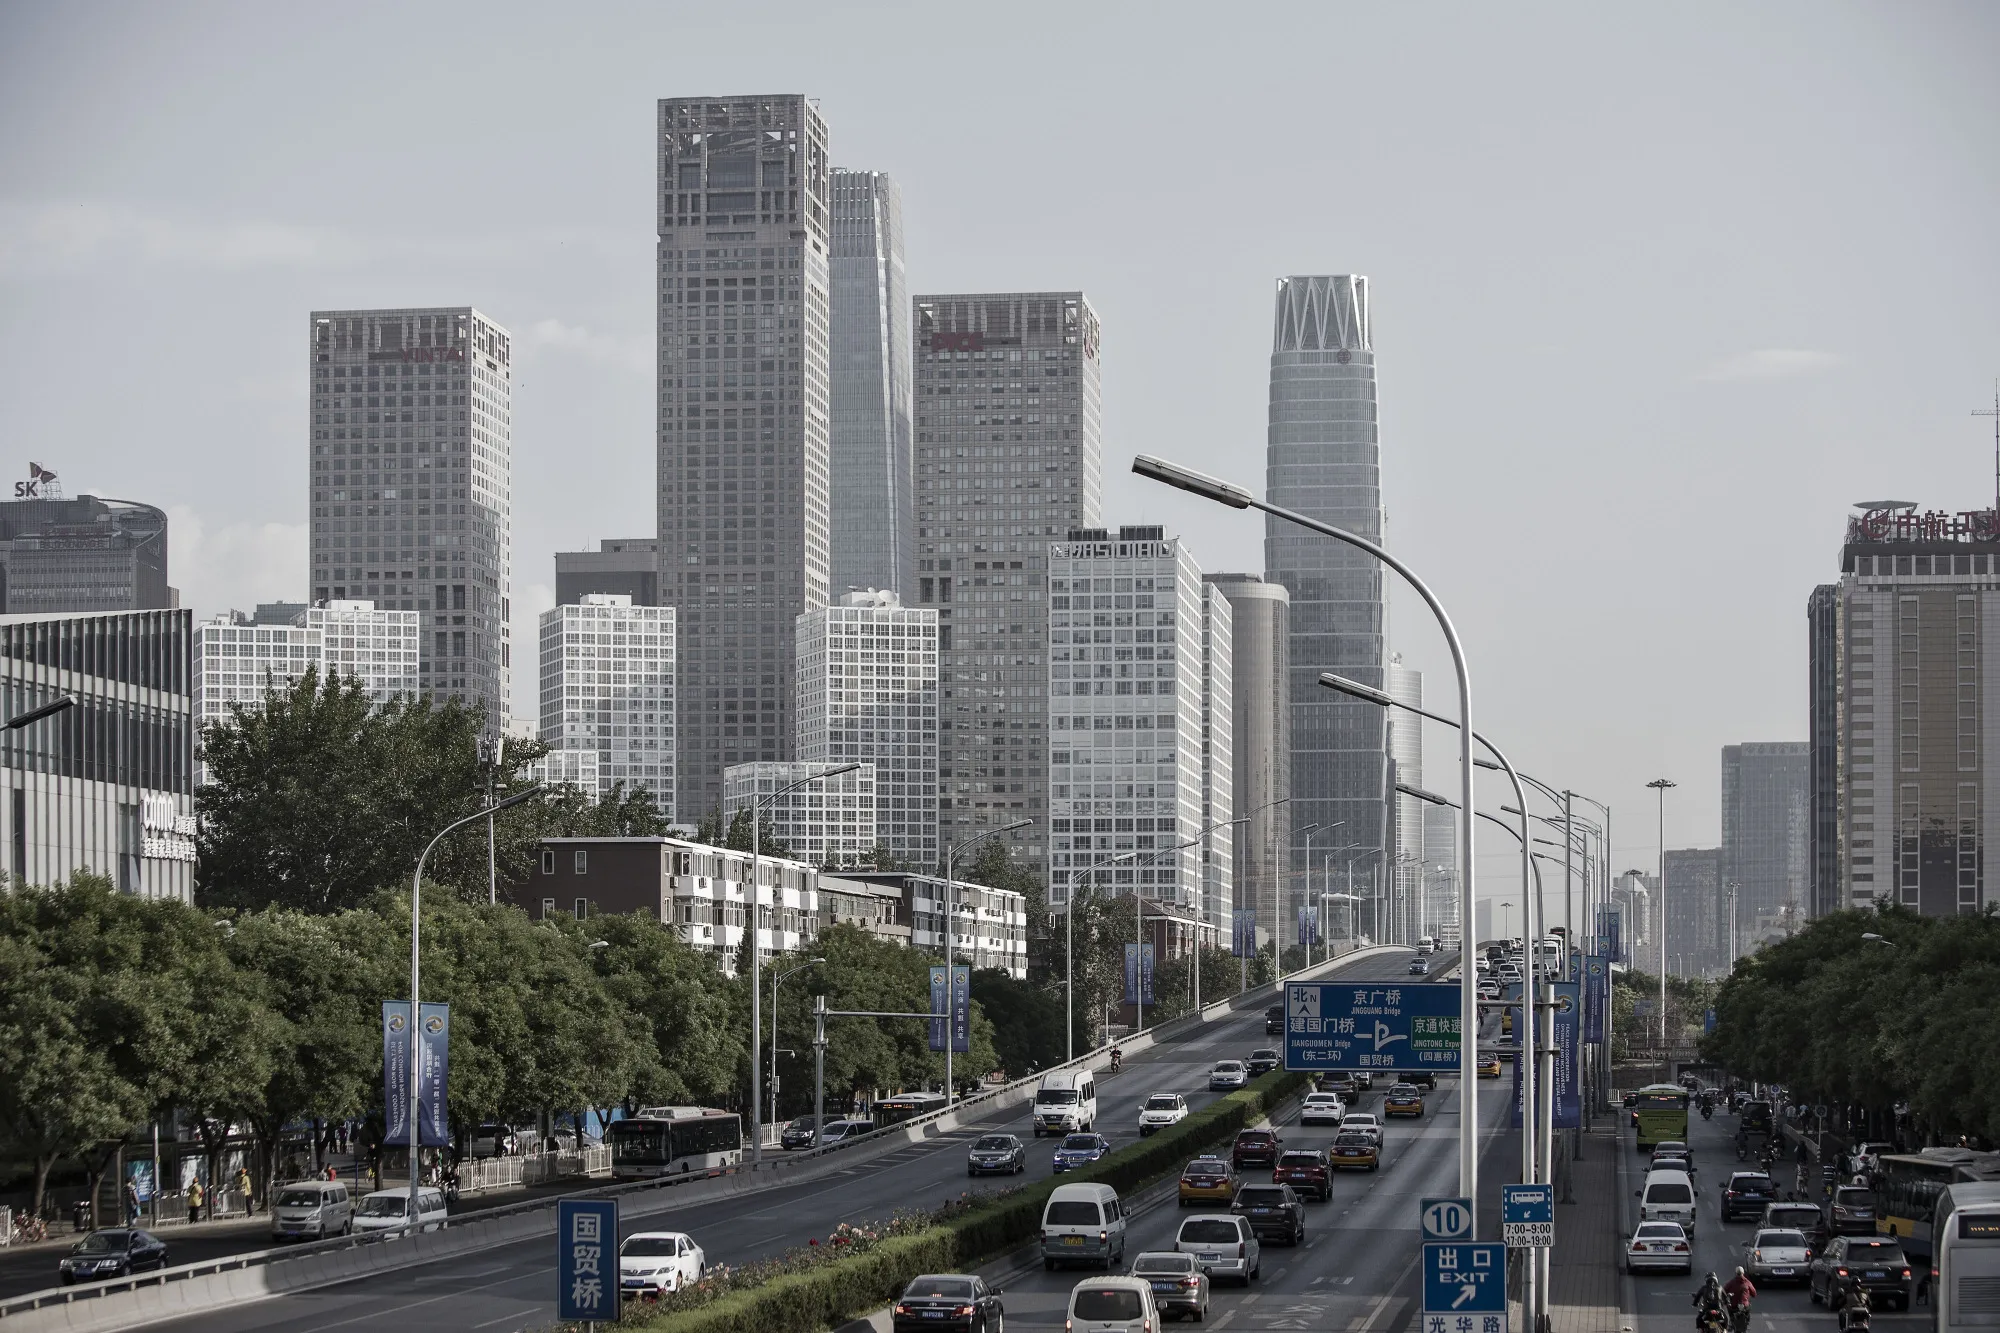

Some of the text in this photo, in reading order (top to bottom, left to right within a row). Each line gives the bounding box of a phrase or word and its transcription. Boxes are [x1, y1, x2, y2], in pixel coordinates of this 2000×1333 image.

[14, 481, 38, 497] SK
[1293, 988, 1308, 1003] 北
[1310, 995, 1317, 1003] N
[1353, 989, 1401, 1006] 京广桥
[1351, 1006, 1401, 1016] JINGGUANG Bridge
[1289, 1017, 1355, 1034] 建国门桥
[1414, 1018, 1462, 1034] 京通快速
[1291, 1039, 1352, 1049] JIANGUOMEN Bridge
[1413, 1039, 1443, 1048] JINGTONG
[1359, 1054, 1395, 1067] 国贸桥
[1431, 1206, 1460, 1233] 10
[1505, 1223, 1551, 1234] 7:00-9:00
[1506, 1235, 1551, 1247] 17:00-19:00
[571, 1212, 603, 1310] 国贸桥
[1438, 1247, 1491, 1270] 出口
[1439, 1272, 1490, 1284] EXIT
[1429, 1315, 1501, 1333] 光华路
